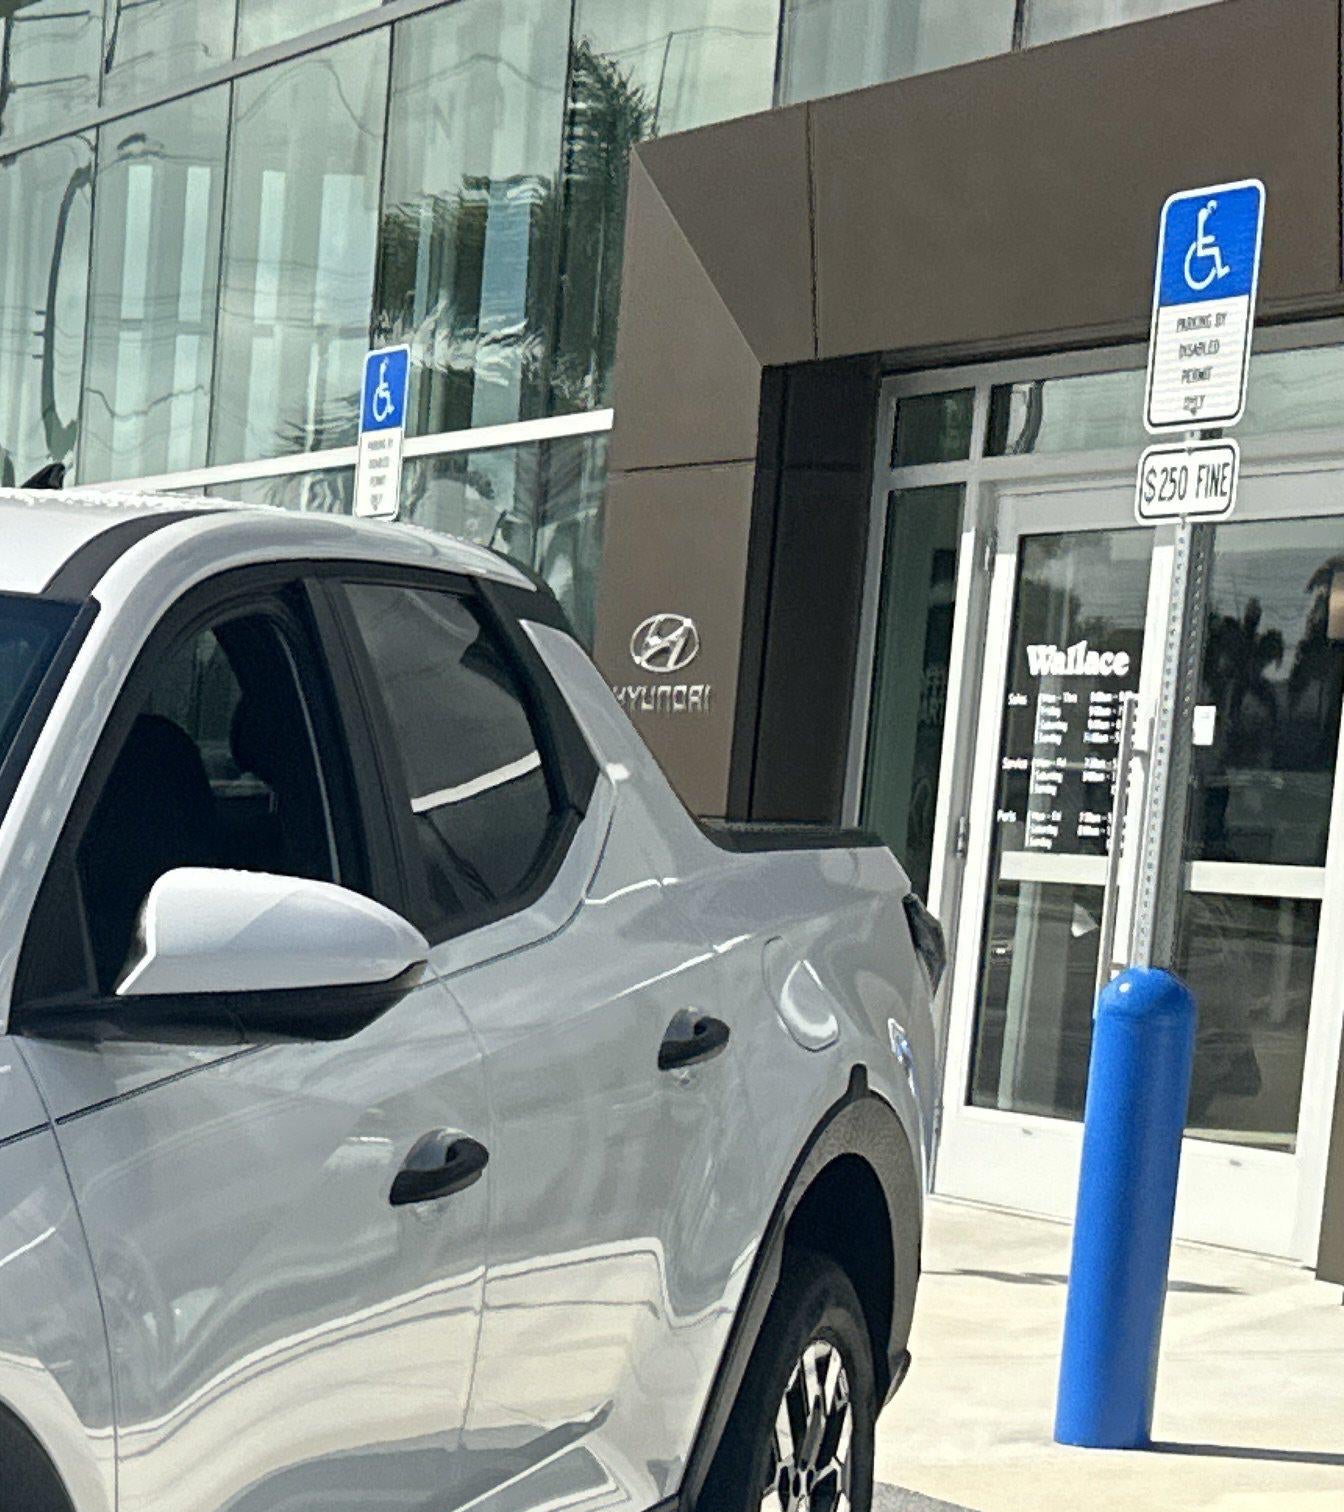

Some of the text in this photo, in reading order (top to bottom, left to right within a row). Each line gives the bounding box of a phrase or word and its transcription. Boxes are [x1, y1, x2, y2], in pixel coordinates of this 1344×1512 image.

[1144, 462, 1230, 504] $250 FINE
[1026, 640, 1130, 677] Wallace
